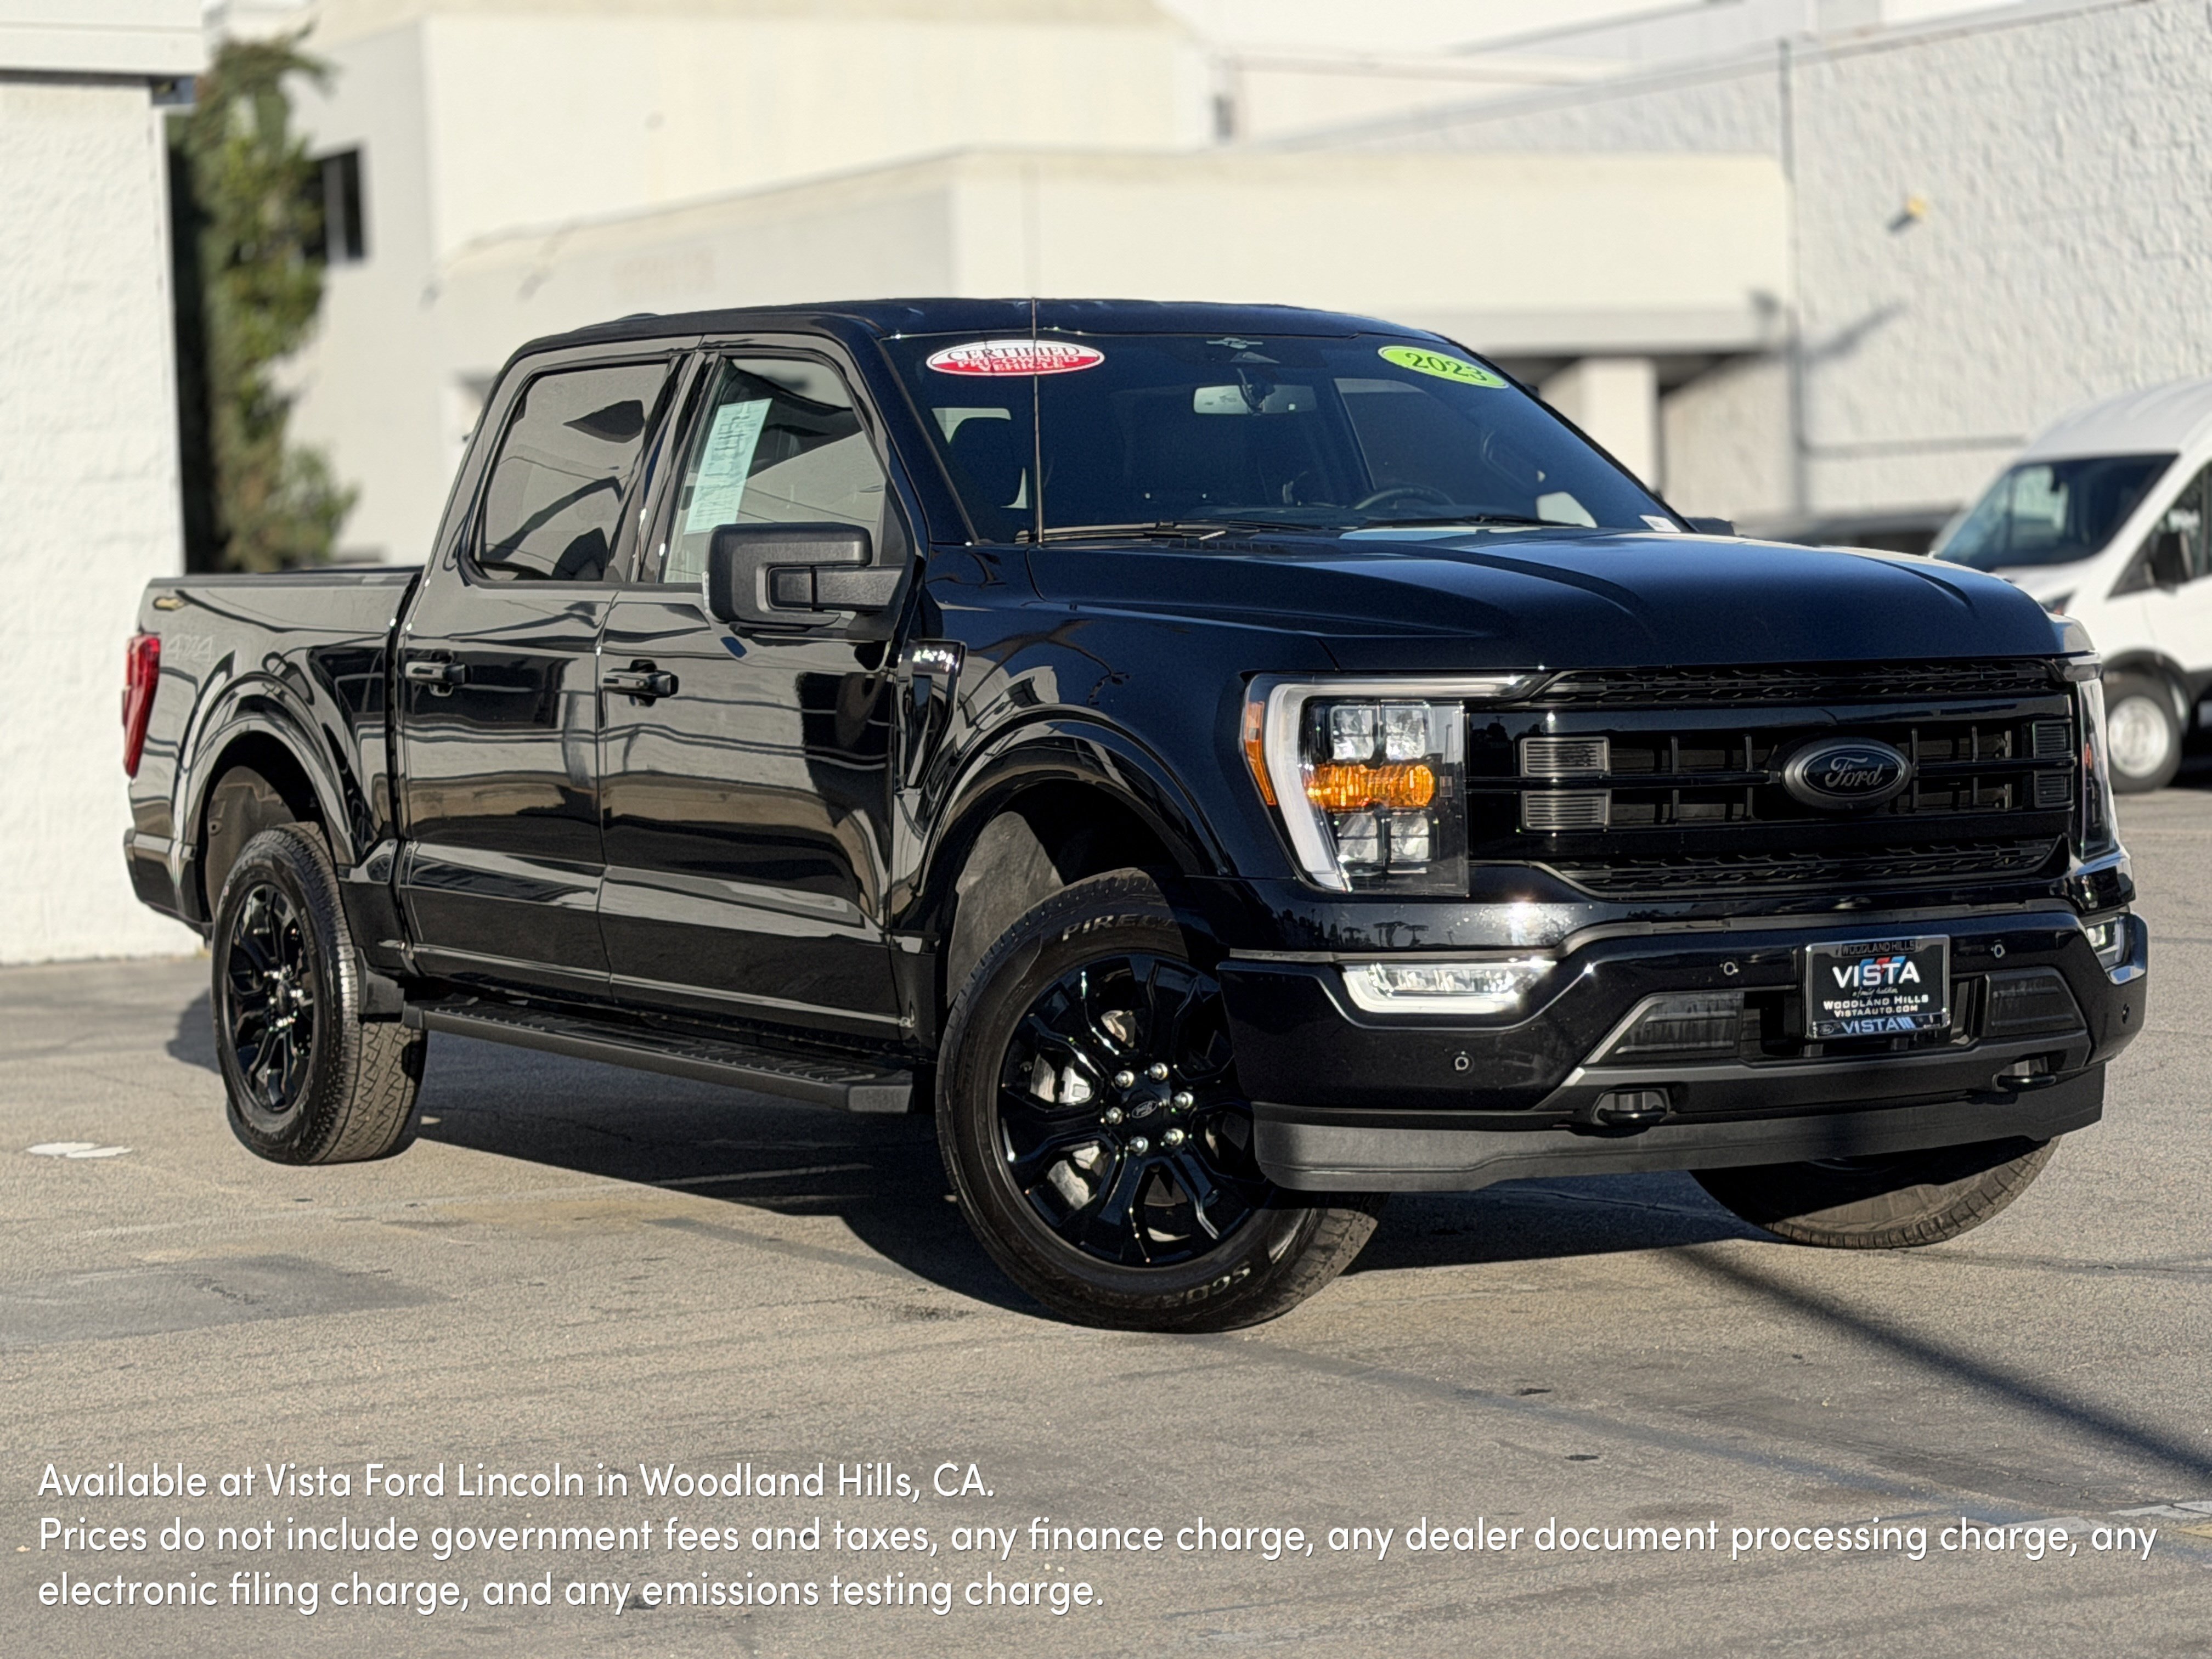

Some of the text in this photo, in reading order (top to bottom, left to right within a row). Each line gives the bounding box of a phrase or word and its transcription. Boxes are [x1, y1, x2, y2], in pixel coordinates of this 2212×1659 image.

[947, 346, 1080, 361] CERTIFIED
[978, 362, 1065, 371] VEHICLE
[1404, 352, 1487, 381] 2023
[1825, 756, 1883, 788] Ford
[1842, 940, 1915, 956] WOODLAND HILLS
[1832, 961, 1920, 988] VISTA
[1841, 1018, 1899, 1034] VISTA
